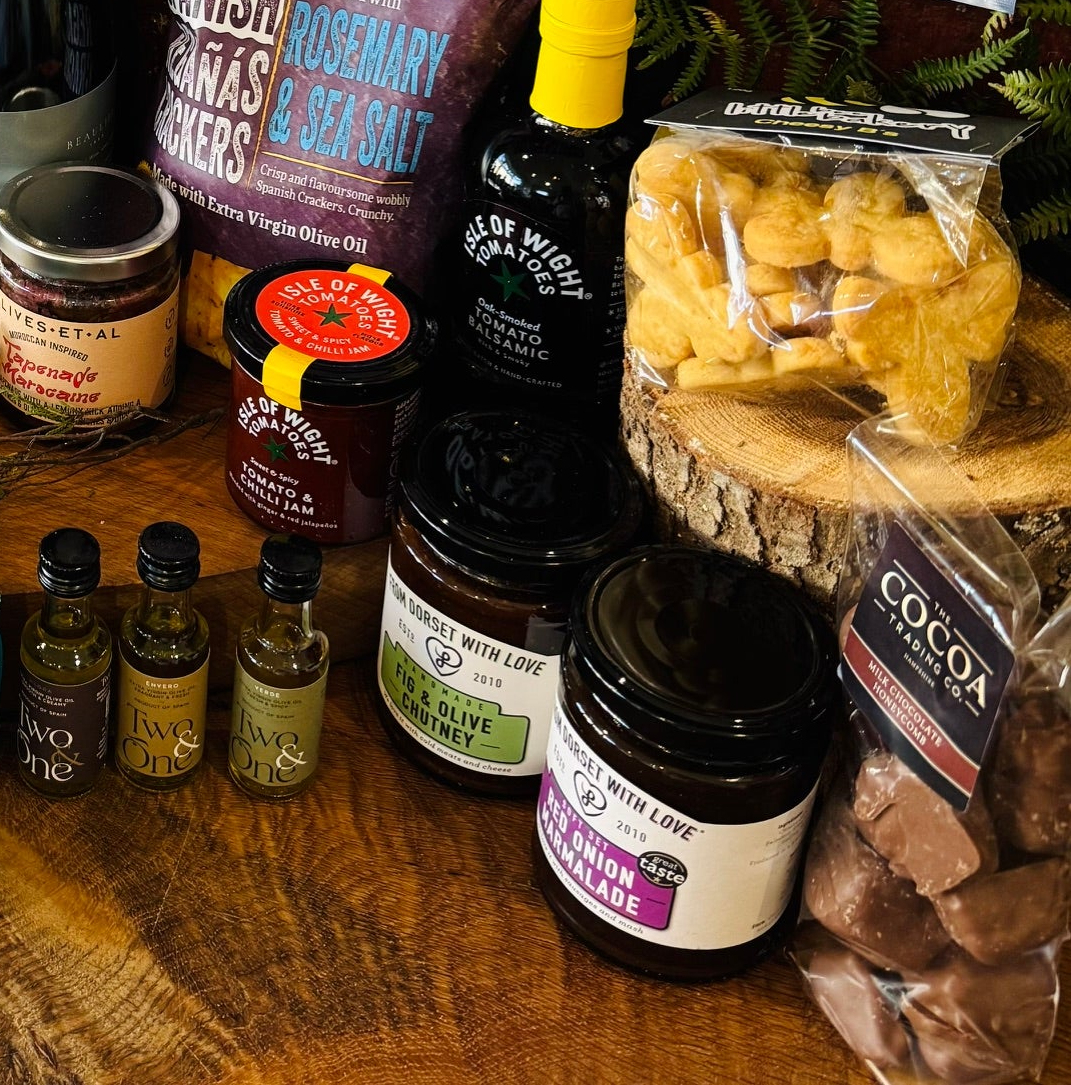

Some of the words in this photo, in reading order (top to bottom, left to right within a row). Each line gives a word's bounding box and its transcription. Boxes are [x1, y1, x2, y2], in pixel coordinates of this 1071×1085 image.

[282, 0, 450, 99] ROSEMARY
[268, 77, 295, 146] &
[299, 83, 356, 162] SEA
[357, 99, 434, 174] SALT
[178, 182, 206, 210] with
[207, 195, 245, 223] Extra
[246, 209, 297, 241] Virgin
[298, 224, 341, 250] Olive
[343, 236, 368, 255] Oil
[255, 179, 296, 203] Spanish
[297, 191, 346, 214] Crackers.
[348, 204, 395, 224] Crunchy.
[259, 163, 287, 184] Crisp
[288, 170, 307, 187] and
[308, 174, 375, 204] flavoursome
[375, 191, 411, 208] wobbly
[464, 215, 489, 258] ISLE
[489, 214, 516, 238] OF
[523, 227, 584, 300] WIGHT
[476, 239, 555, 295] TOMATOES
[298, 292, 373, 330] TOMATOES
[468, 315, 550, 361] BALSAMIC
[475, 306, 542, 345] TOMATO
[477, 297, 541, 332] Oak-Smoked
[2, 335, 99, 389] Tapenade
[409, 599, 458, 642] DORSET
[462, 633, 501, 662] WITH
[504, 652, 547, 676] LOVE
[881, 571, 987, 709] COCOA
[890, 612, 942, 676] TRADING
[944, 676, 963, 703] CO.
[130, 704, 193, 740] Two
[396, 662, 416, 694] FIG
[421, 690, 431, 708] &
[438, 700, 493, 735] OLIVE
[402, 693, 475, 749] CHUTNEY
[873, 682, 928, 747] HONEYCOMB
[562, 727, 604, 782] DORSET
[607, 775, 645, 813] WITH
[650, 808, 699, 842] LOVE
[541, 808, 641, 916] MARMALADE
[547, 786, 569, 829] RED
[572, 830, 636, 889] ONION
